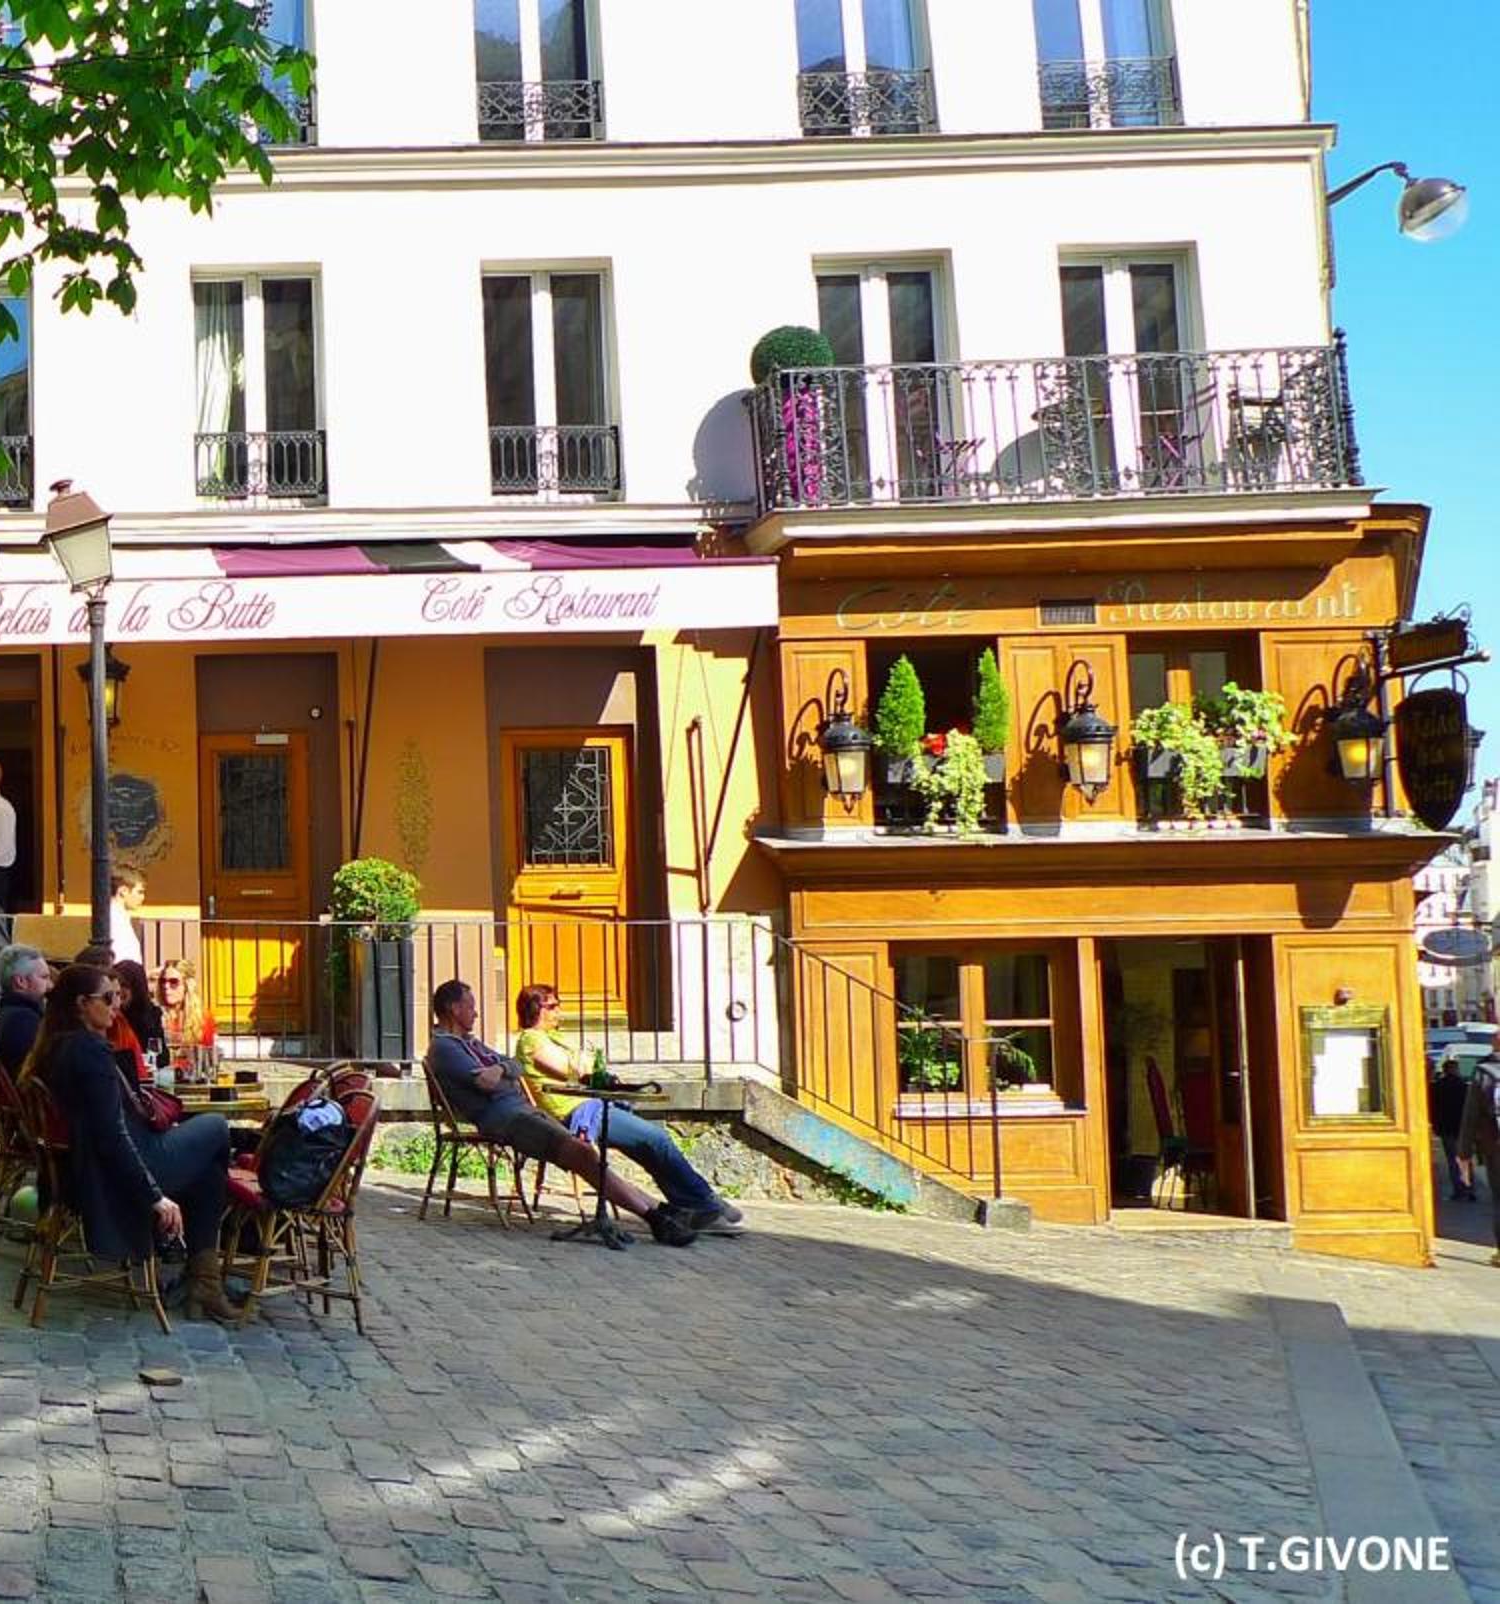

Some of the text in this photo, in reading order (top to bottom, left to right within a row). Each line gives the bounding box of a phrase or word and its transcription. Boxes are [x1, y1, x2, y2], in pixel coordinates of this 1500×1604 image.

[118, 583, 152, 633] la
[167, 582, 277, 632] Butte
[503, 575, 661, 626] Restaurant
[1106, 577, 1362, 622] Restaurant
